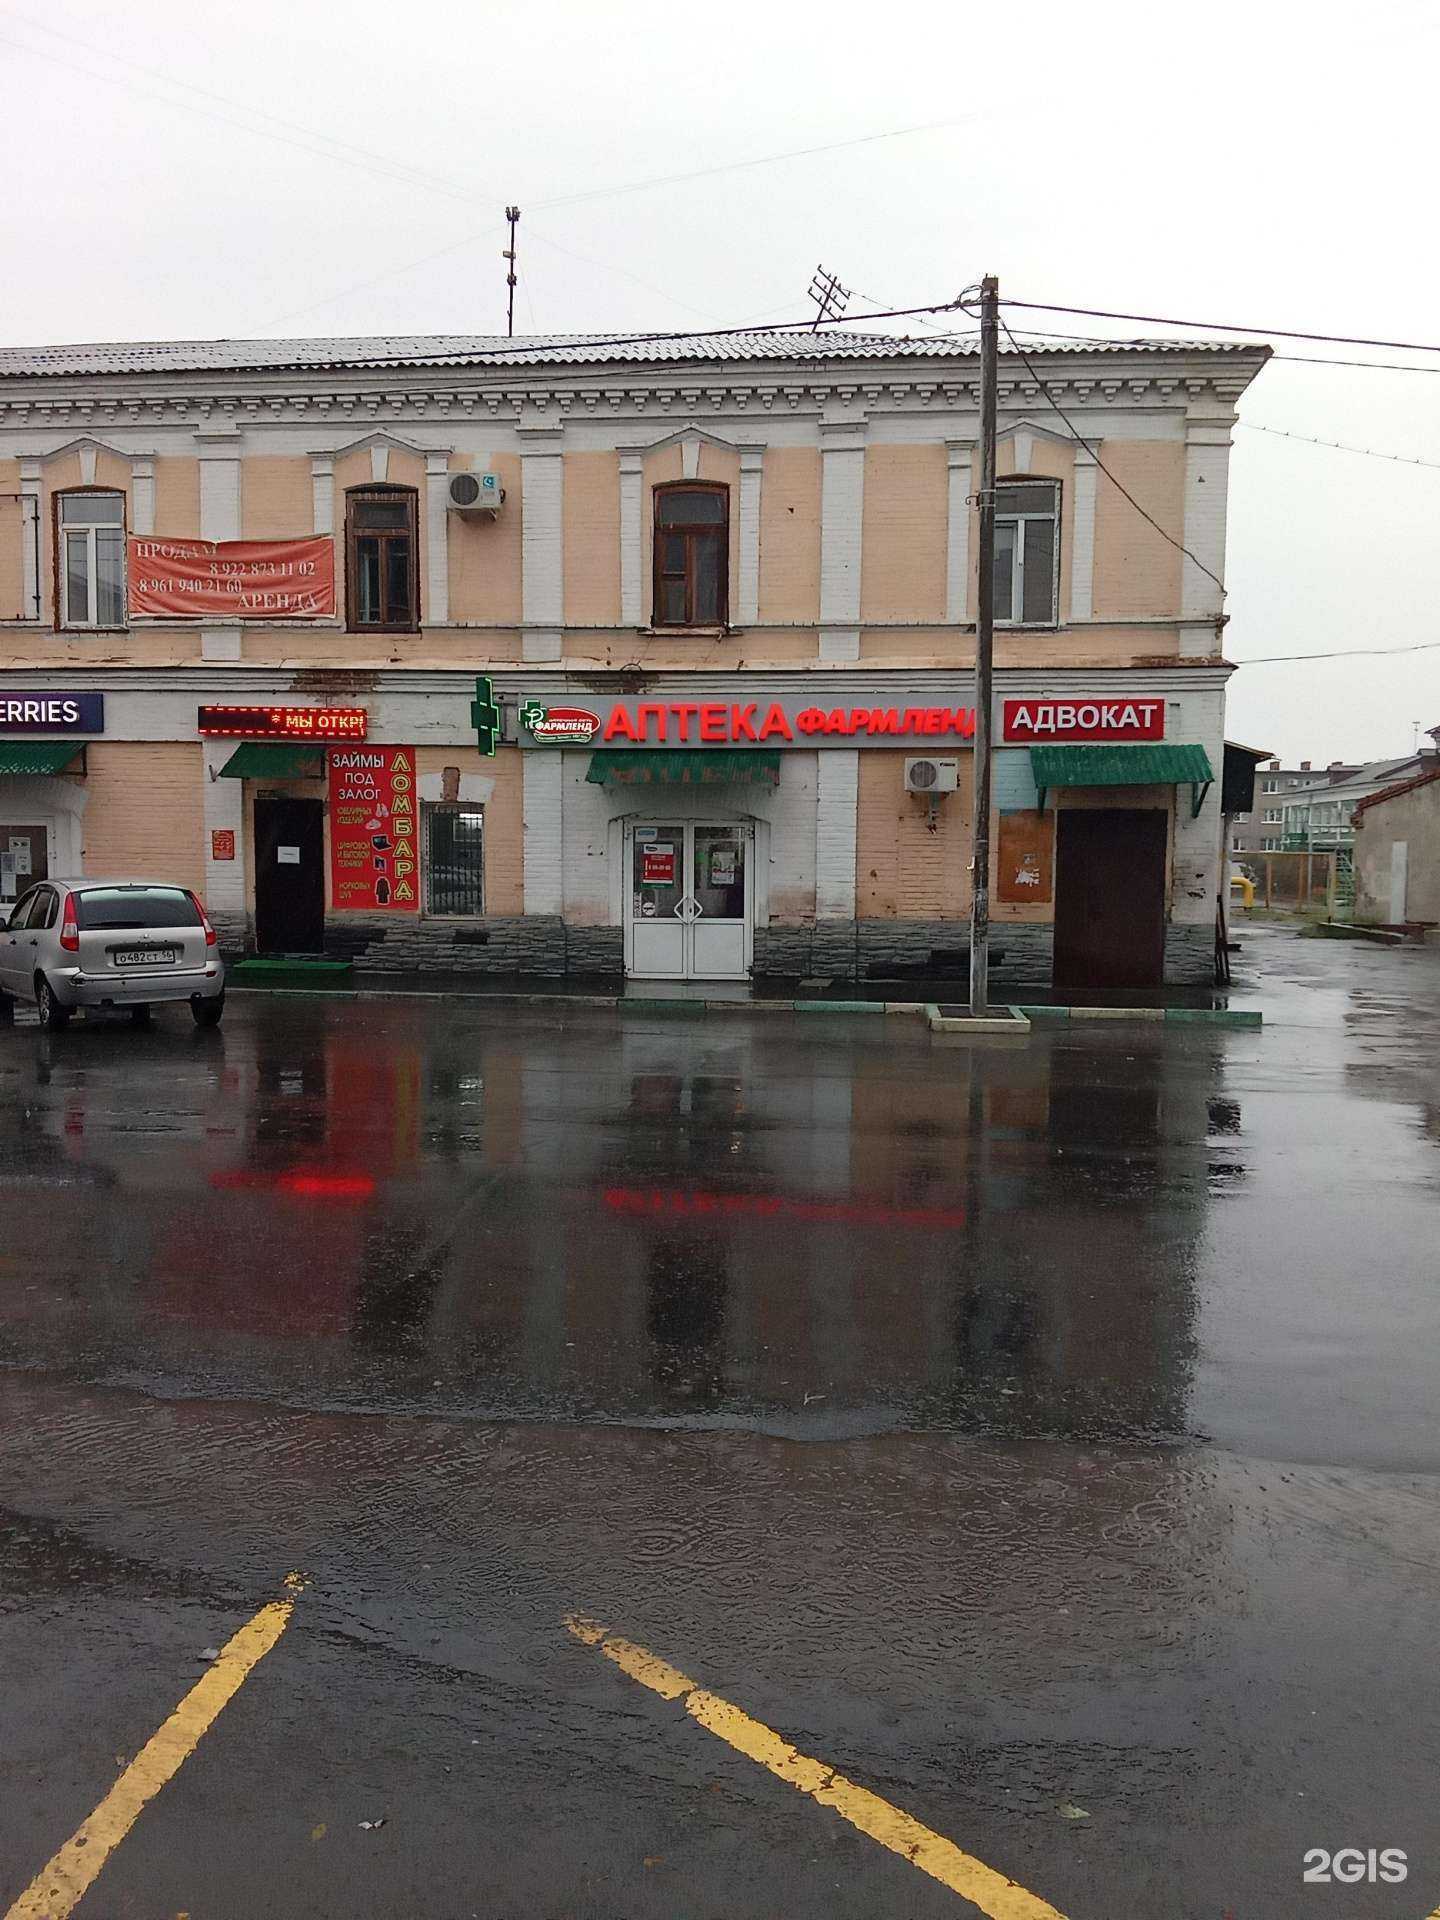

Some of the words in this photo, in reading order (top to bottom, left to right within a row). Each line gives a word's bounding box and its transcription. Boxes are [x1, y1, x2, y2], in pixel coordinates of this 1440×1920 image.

[136, 543, 217, 560] ПРОДАМ
[210, 562, 218, 576] 8
[222, 562, 246, 576] 922
[251, 562, 276, 576] 873
[280, 562, 294, 576] 11
[299, 562, 315, 576] 02
[139, 579, 148, 593] 8
[152, 579, 173, 593] 961
[178, 579, 202, 593] 940
[207, 579, 220, 593] 21
[227, 579, 242, 593] 60
[238, 593, 317, 612] АРЕНДА
[286, 715, 313, 728] МЫ
[603, 703, 794, 742] АПТЕКА
[1011, 704, 1158, 734] АДВОКАТ
[535, 721, 593, 733] ФАРМЛЕНД
[332, 751, 384, 768] ЗАЙМЫ
[345, 772, 375, 786] ПОД
[338, 788, 382, 800] ЗАЛОГ
[390, 752, 414, 900] ЛОМБАРД
